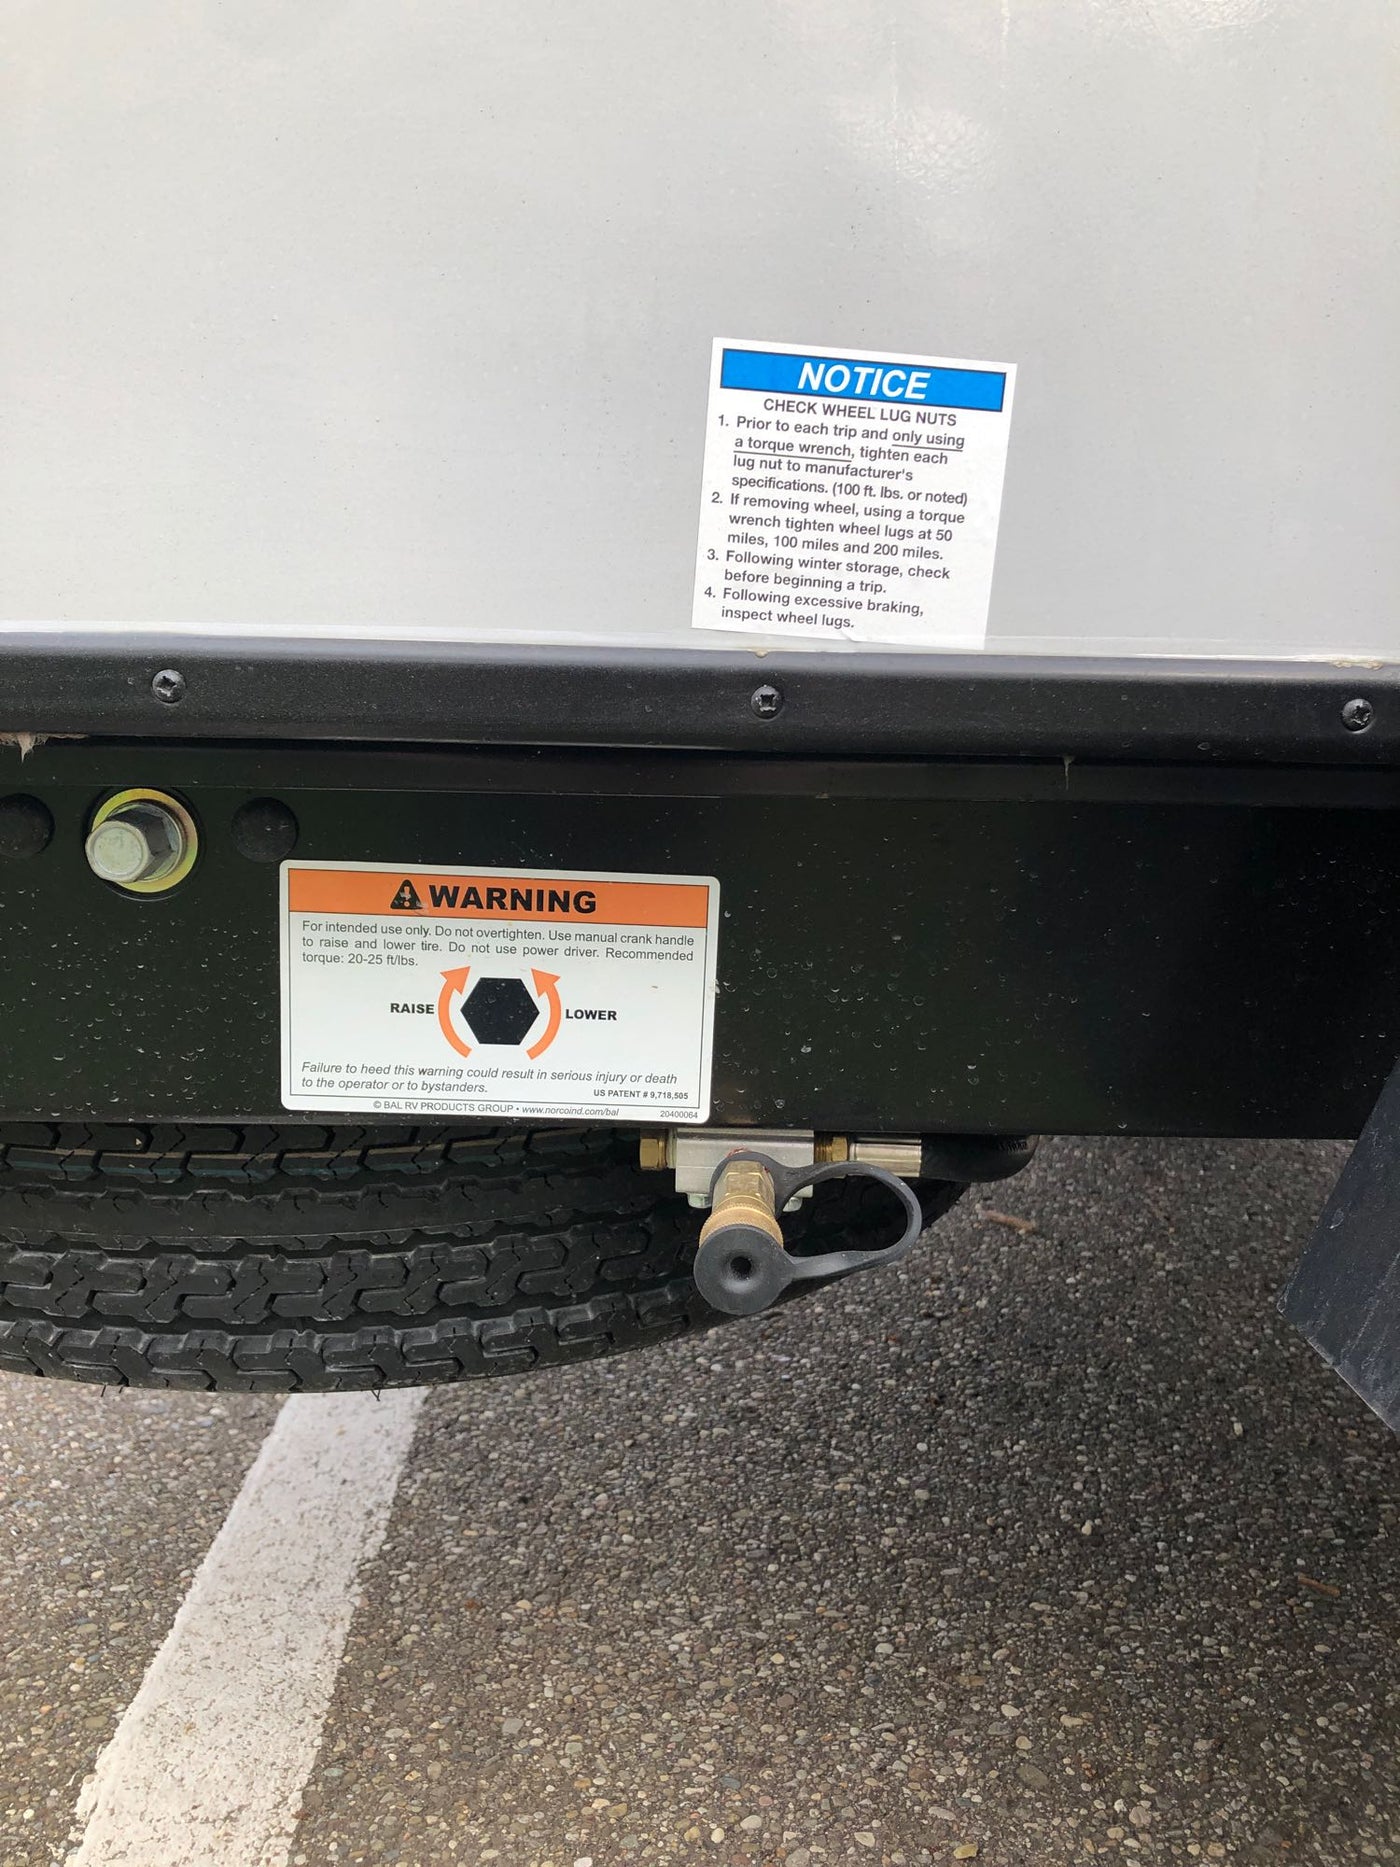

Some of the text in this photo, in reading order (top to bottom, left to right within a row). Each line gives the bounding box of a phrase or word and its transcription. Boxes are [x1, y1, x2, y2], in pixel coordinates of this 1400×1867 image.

[797, 362, 932, 400] NOTICE
[763, 398, 957, 427] CHECK WHEEL LUG NUTS
[718, 414, 965, 450] 1. Prior to each trip and only using
[734, 436, 948, 465] a torque wrench, tighten each
[733, 454, 913, 482] lug nut to manufacturer's
[731, 476, 968, 508] specifications. (100 ft. lbs. or noted)
[711, 491, 965, 525] 2. If removing wheel, using a torque
[728, 514, 953, 542] wrench tighten wheel lugs at 50
[727, 532, 943, 560] miles, 100 miles and 200 miles.
[707, 548, 950, 580] 3. Following winter storage, check
[724, 568, 887, 595] before beginning a trip.
[704, 586, 924, 617] 4. Following excessive braking,
[721, 605, 855, 630] inspect wheel lugs.
[428, 884, 597, 914] WARNING
[302, 919, 695, 947] For intended use only. Do not overtighten. Use manual crank handle
[302, 936, 694, 962] to raise and lower tire. Do not use power driver. Recommended
[302, 951, 418, 966] torque: 20-25 ft/lbs.
[390, 1002, 435, 1015] RAISE
[565, 1008, 617, 1021] LOWER
[301, 1061, 678, 1085] Failure to heed this warning could result in serious injury or death
[301, 1077, 488, 1094] to the operator or to bystanders.
[383, 1100, 403, 1110] BAL
[404, 1101, 419, 1110] RV
[420, 1101, 476, 1112] PRODUCTS
[477, 1103, 514, 1113] GROUP
[521, 1106, 620, 1117] www.norcoind.com/bal
[593, 1089, 606, 1097] US
[607, 1089, 641, 1098] PATENT
[649, 1091, 689, 1100] 9,718,505
[659, 1110, 698, 1119] 20400064
